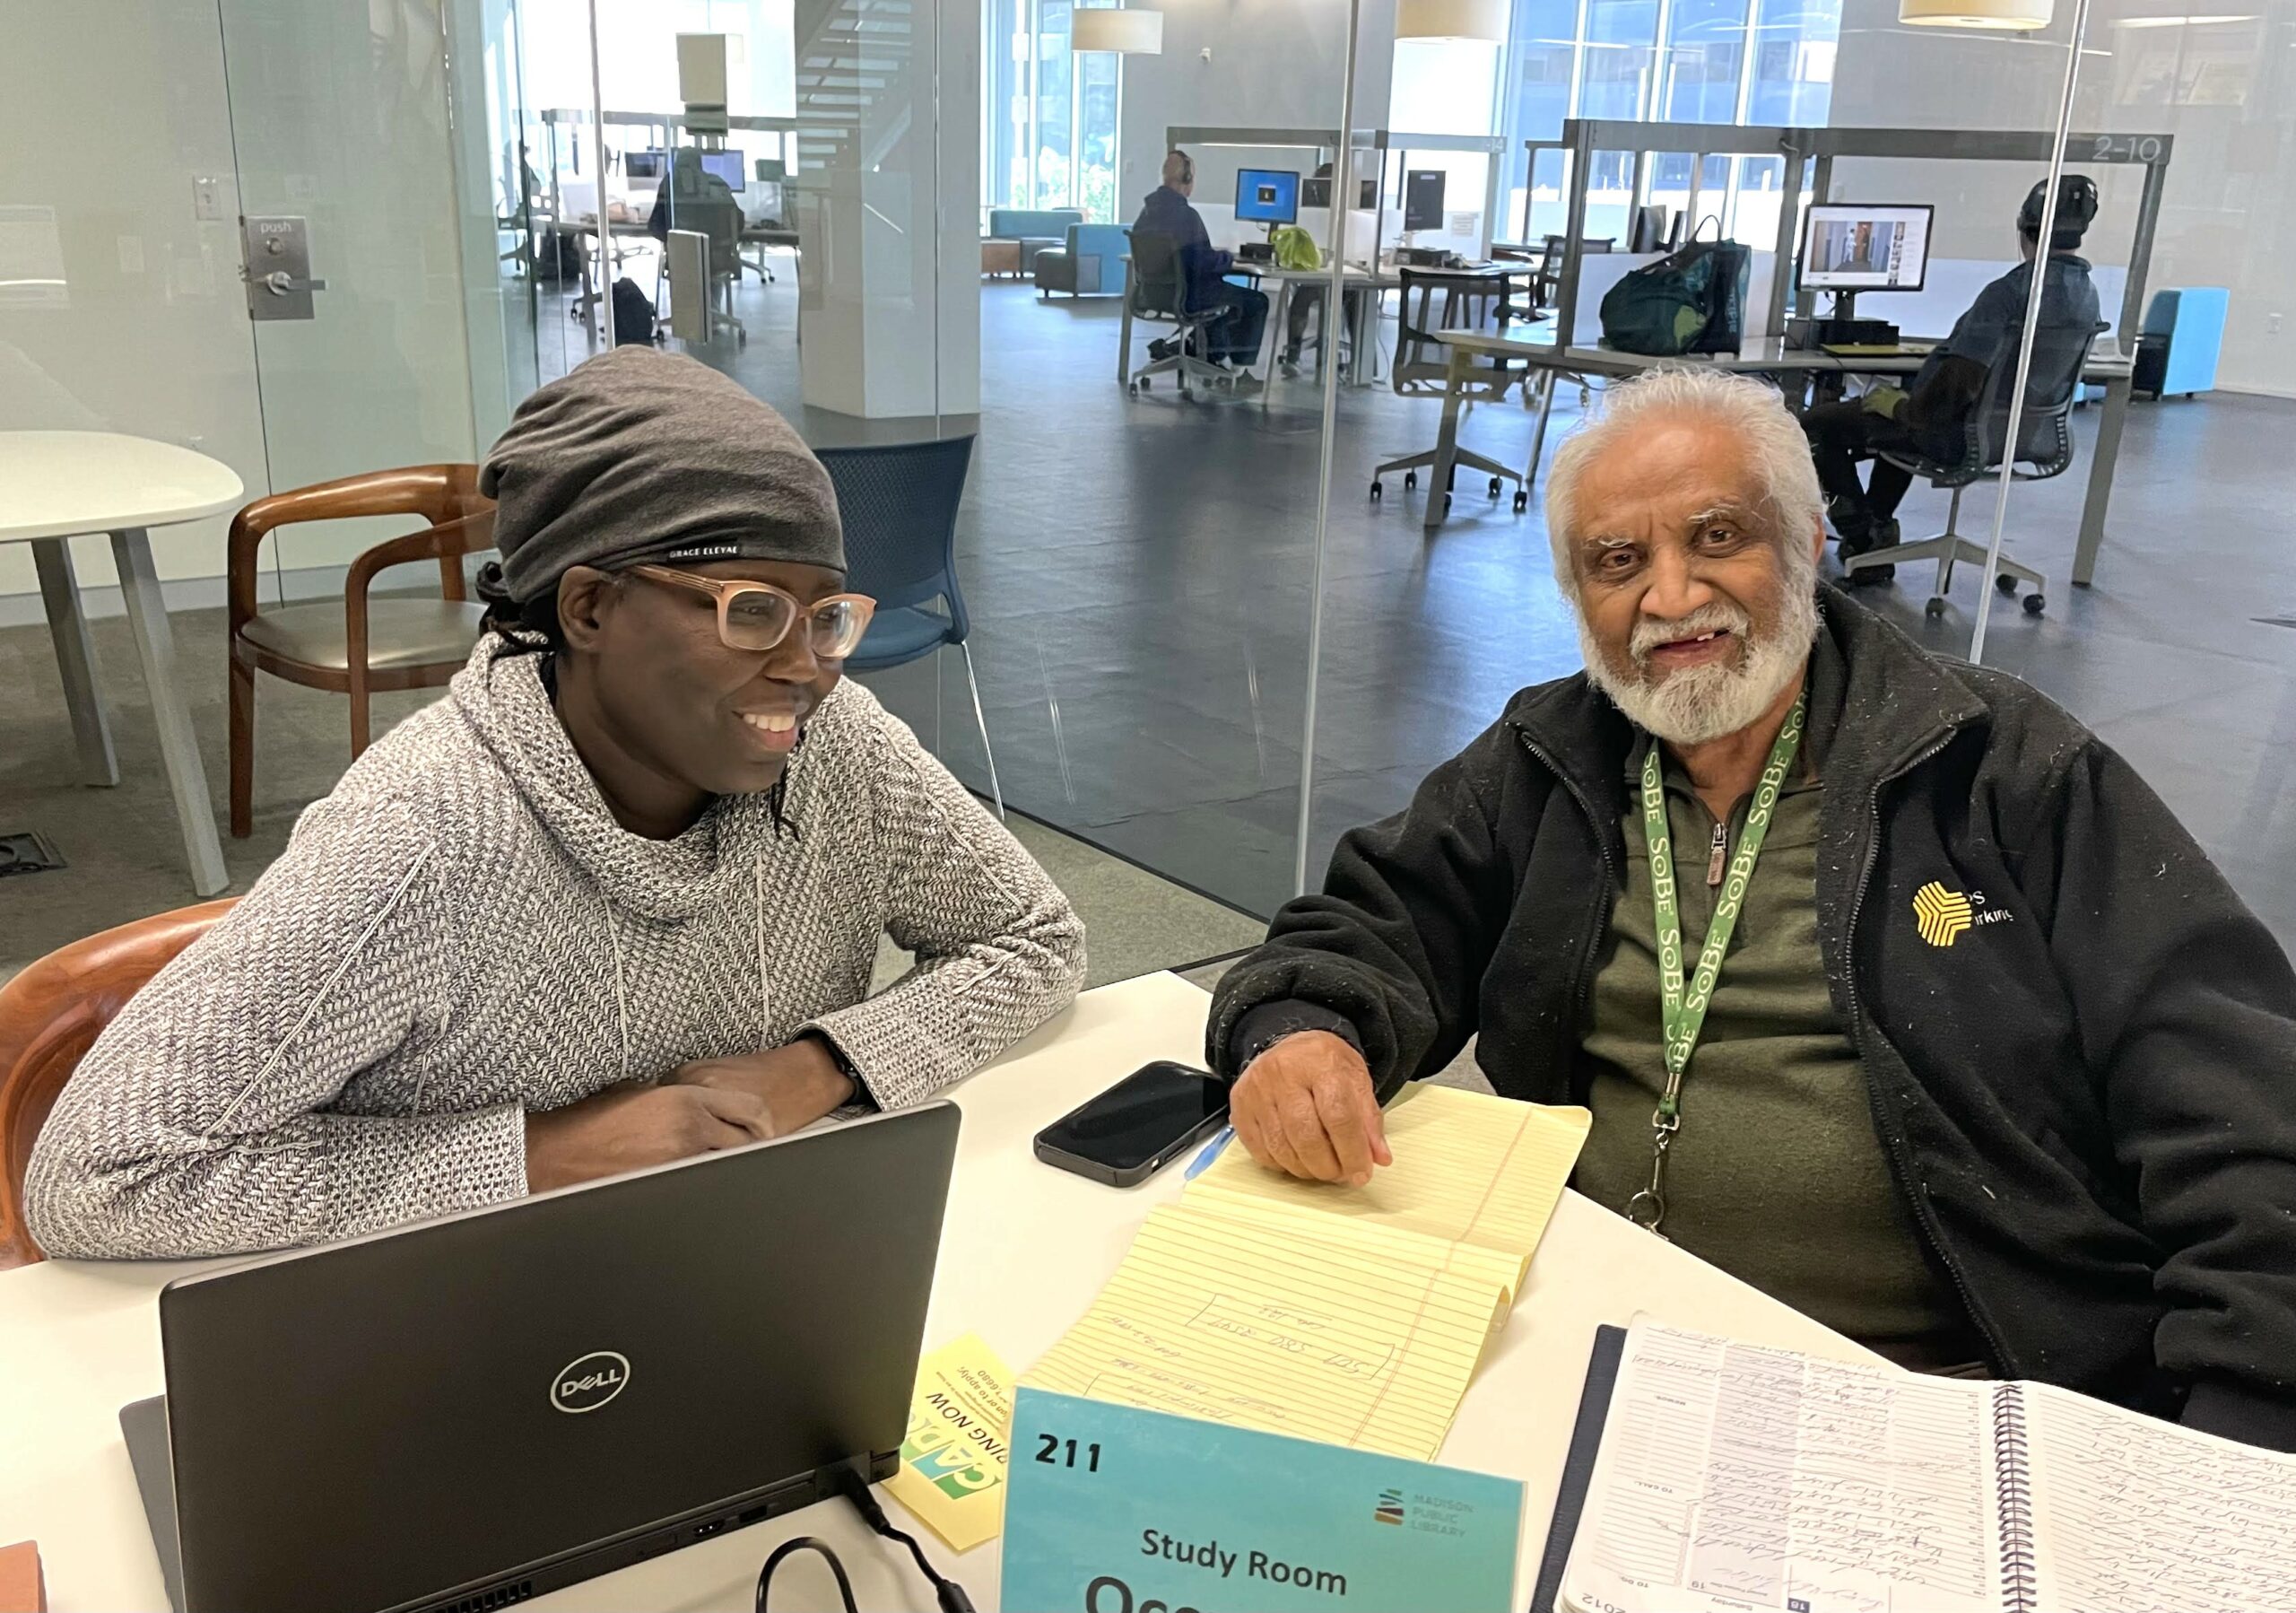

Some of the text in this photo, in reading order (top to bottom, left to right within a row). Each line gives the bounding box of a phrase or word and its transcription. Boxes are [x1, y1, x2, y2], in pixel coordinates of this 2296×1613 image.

[2092, 135, 2161, 162] 2-10
[260, 222, 292, 234] push
[669, 548, 700, 559] GRACE
[561, 1369, 622, 1398] DELL
[926, 1392, 974, 1428] NOW
[1035, 1434, 1101, 1472] 211
[1413, 1495, 1474, 1513] MADISON
[1413, 1506, 1459, 1524] PUBLIC
[1411, 1521, 1467, 1538] LIBRARY
[1141, 1528, 1238, 1578] Study
[1248, 1550, 1347, 1597] Room
